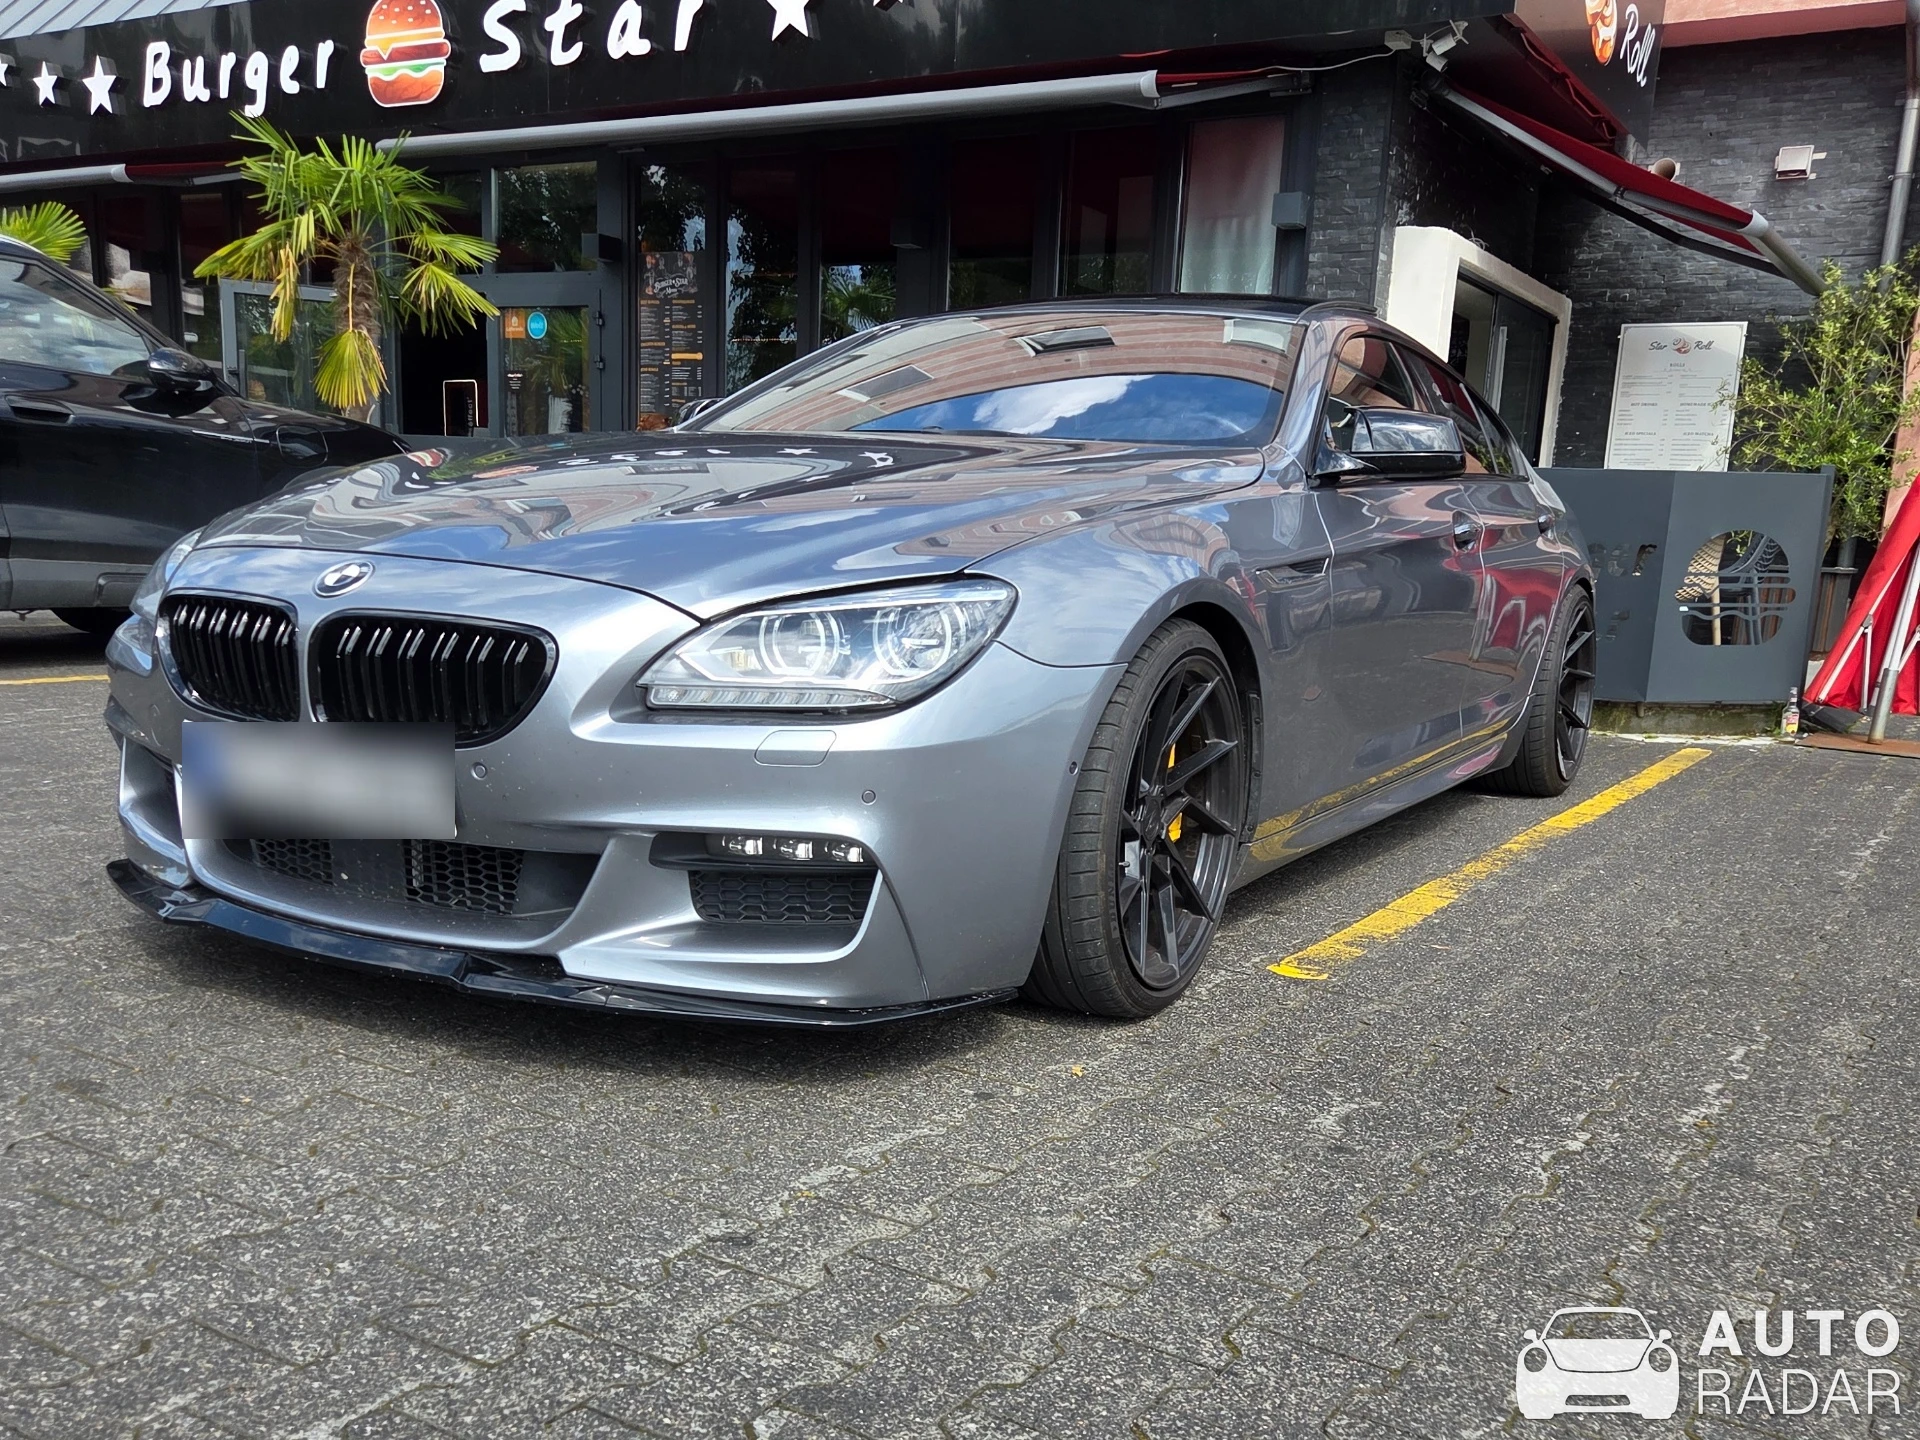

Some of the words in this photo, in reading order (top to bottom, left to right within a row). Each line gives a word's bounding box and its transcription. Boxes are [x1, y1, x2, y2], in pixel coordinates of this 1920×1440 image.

[143, 39, 334, 118] Burger
[479, 0, 704, 73] Star
[1619, 3, 1656, 88] Roll
[1648, 341, 1668, 350] Star
[1693, 340, 1714, 350] Roll
